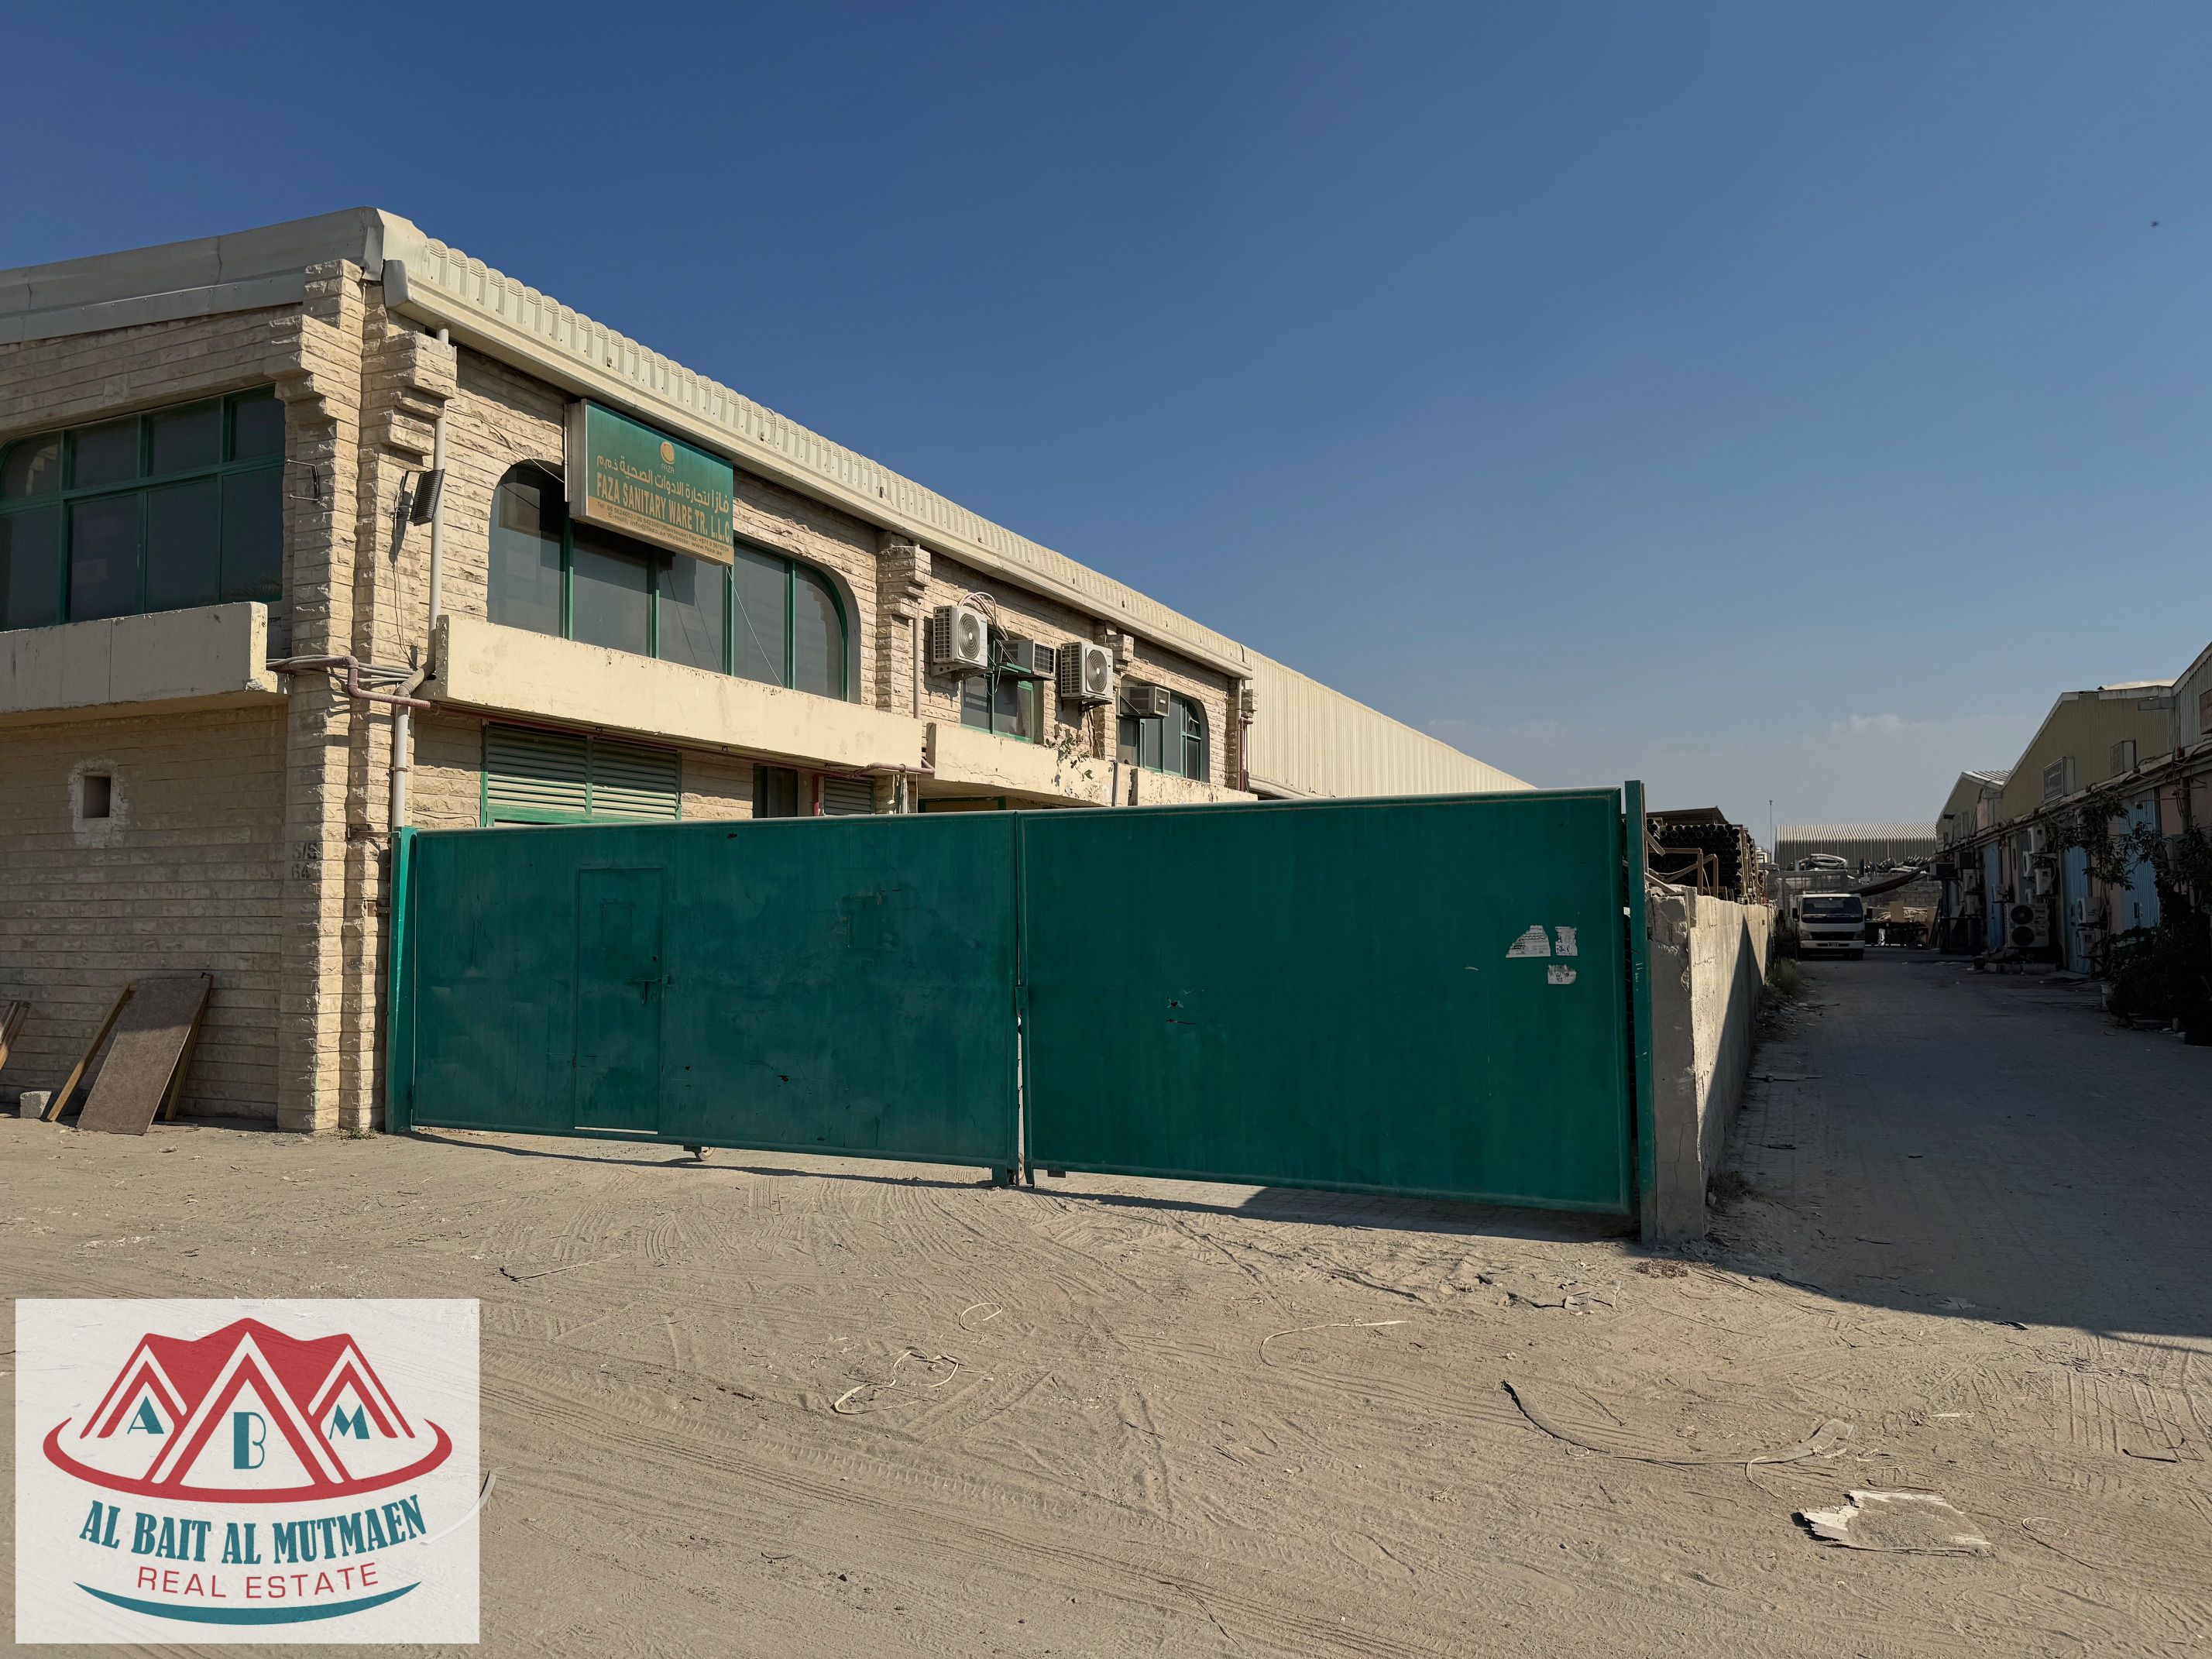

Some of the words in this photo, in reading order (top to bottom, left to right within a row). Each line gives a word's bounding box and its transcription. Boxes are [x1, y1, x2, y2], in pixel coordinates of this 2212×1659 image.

[620, 455, 653, 485] الصحية
[596, 472, 620, 504] FAZA
[623, 483, 666, 520] SANITARY
[668, 499, 692, 530] WARE
[695, 509, 708, 537] TR.
[711, 515, 733, 544] L.L.C.
[685, 483, 710, 507] لتجارة
[712, 489, 730, 514] فازا
